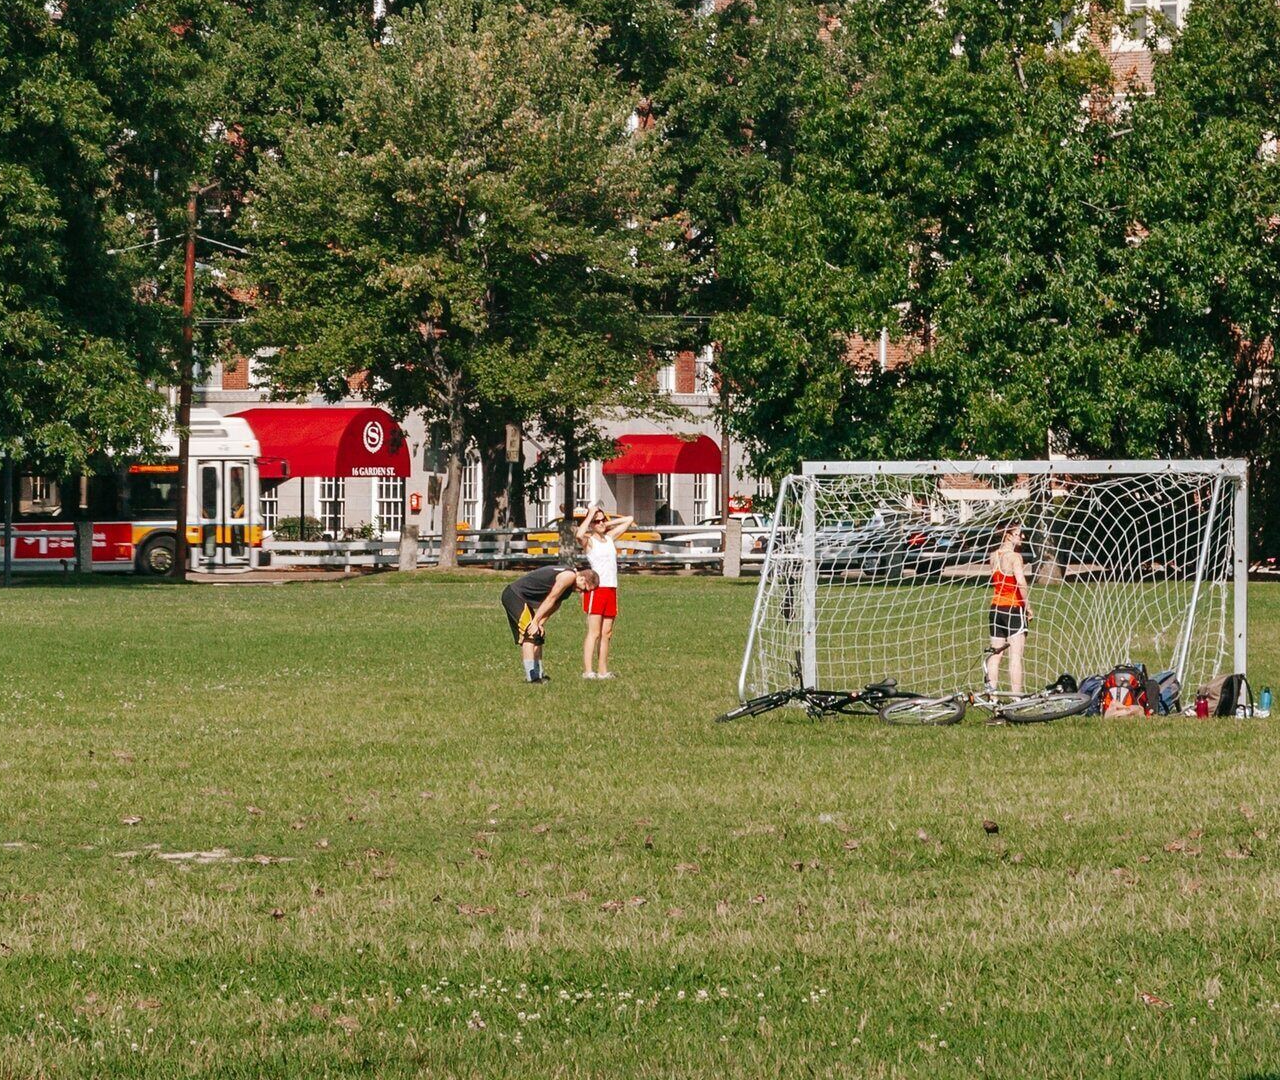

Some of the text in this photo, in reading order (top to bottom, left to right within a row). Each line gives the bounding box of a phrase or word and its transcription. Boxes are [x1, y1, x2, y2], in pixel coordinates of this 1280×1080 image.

[351, 467, 396, 476] 16 GARDEN ST.
